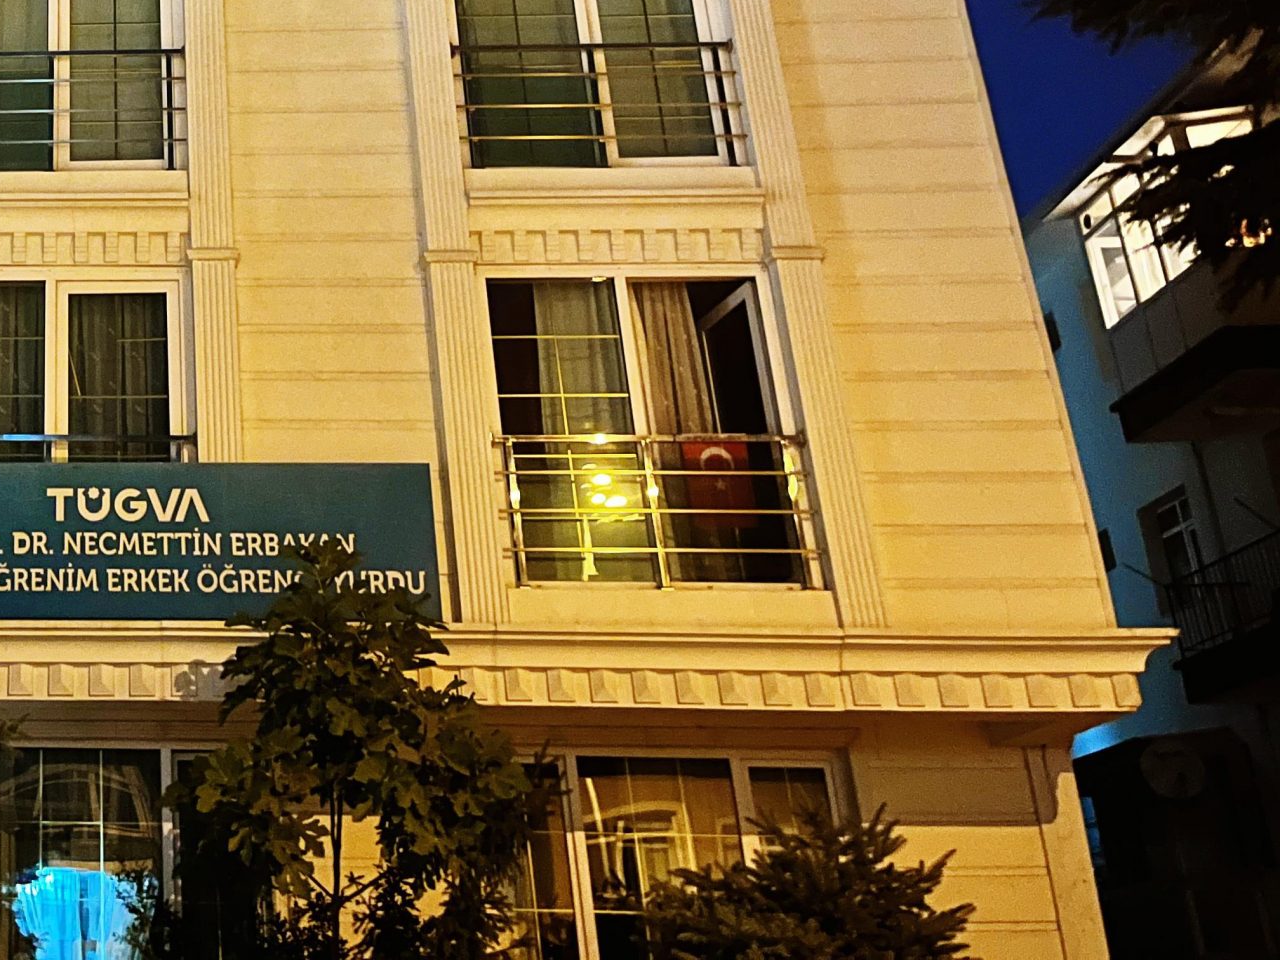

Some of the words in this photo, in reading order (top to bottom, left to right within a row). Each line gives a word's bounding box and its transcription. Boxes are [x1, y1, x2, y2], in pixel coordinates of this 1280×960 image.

[12, 531, 52, 556] DR.
[62, 527, 222, 556] NECMETTİN
[106, 568, 190, 593] ERKEK
[197, 563, 323, 594] ÖĞREN
